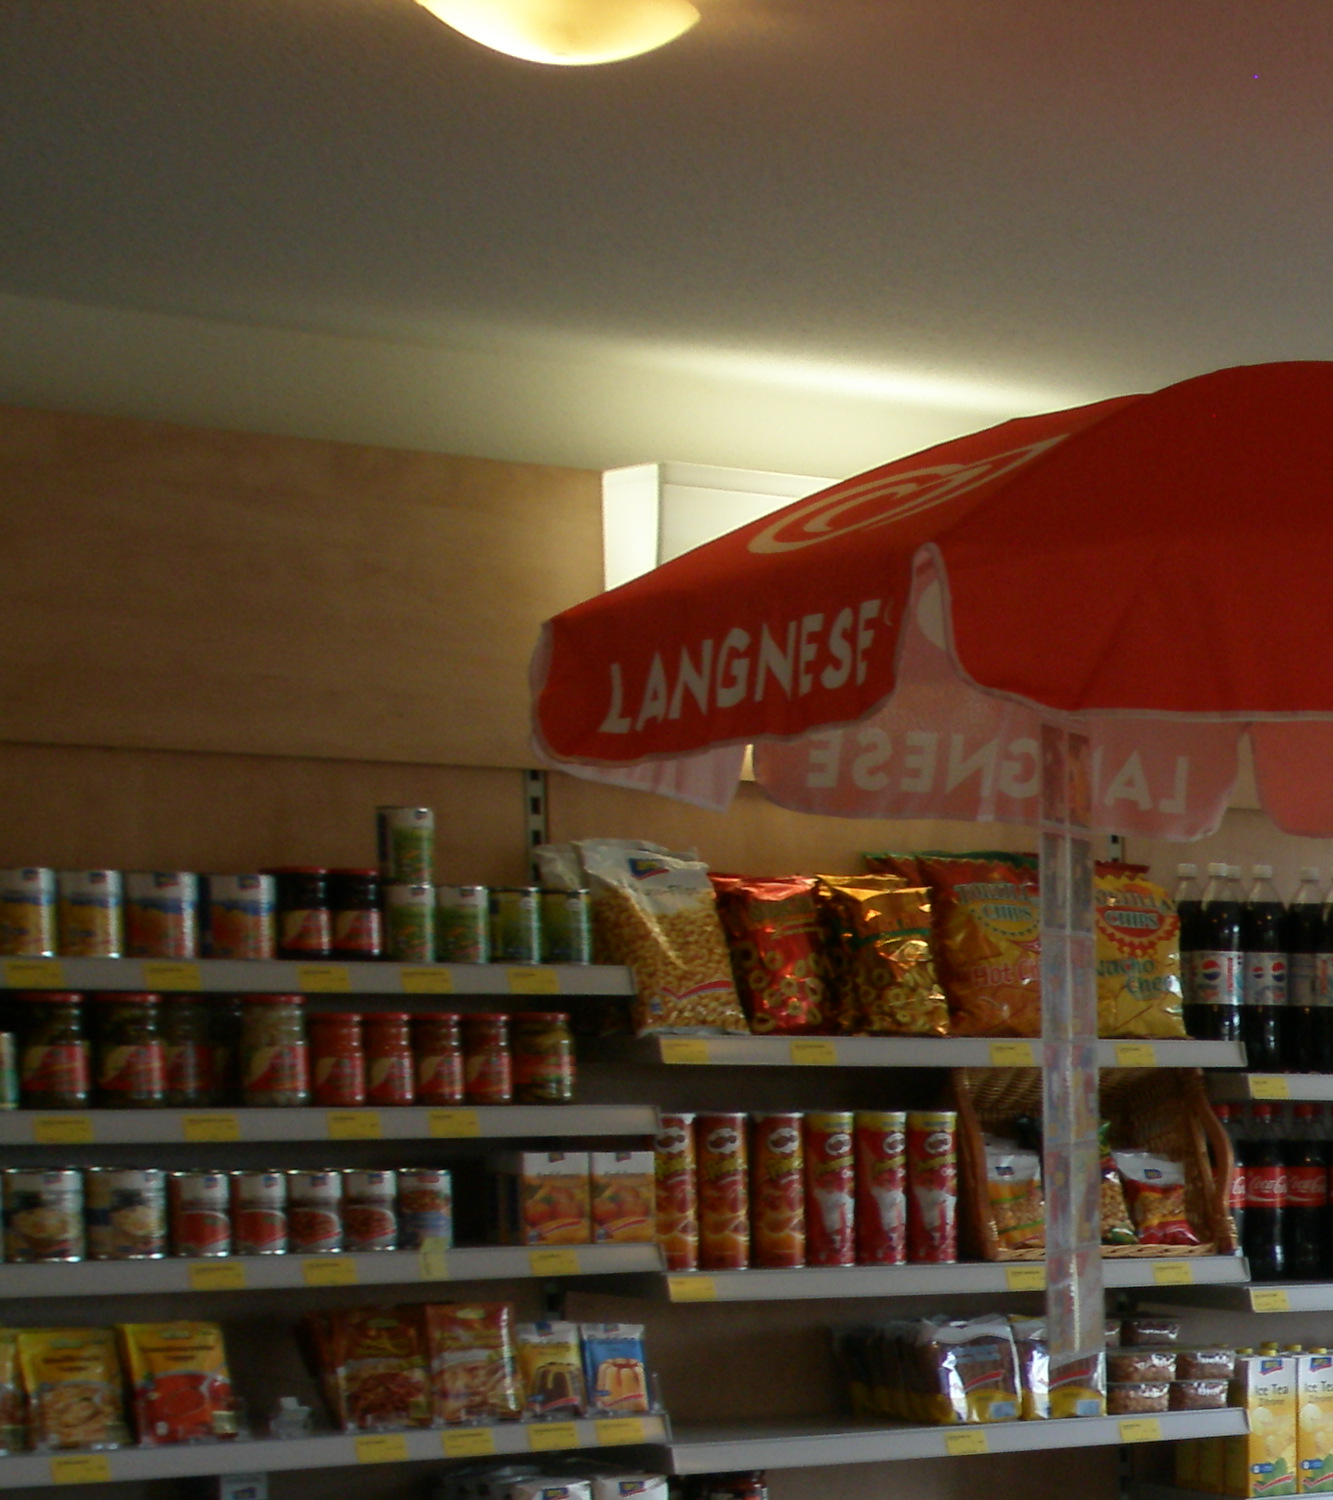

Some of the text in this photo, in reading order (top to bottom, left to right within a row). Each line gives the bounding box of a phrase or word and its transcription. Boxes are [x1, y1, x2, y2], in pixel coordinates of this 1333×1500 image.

[600, 597, 884, 735] LANGNESE
[1104, 910, 1159, 929] CHIPS
[970, 965, 1012, 988] Hot
[1255, 1383, 1289, 1396] Ice Tea
[1304, 1382, 1318, 1393] Ice
